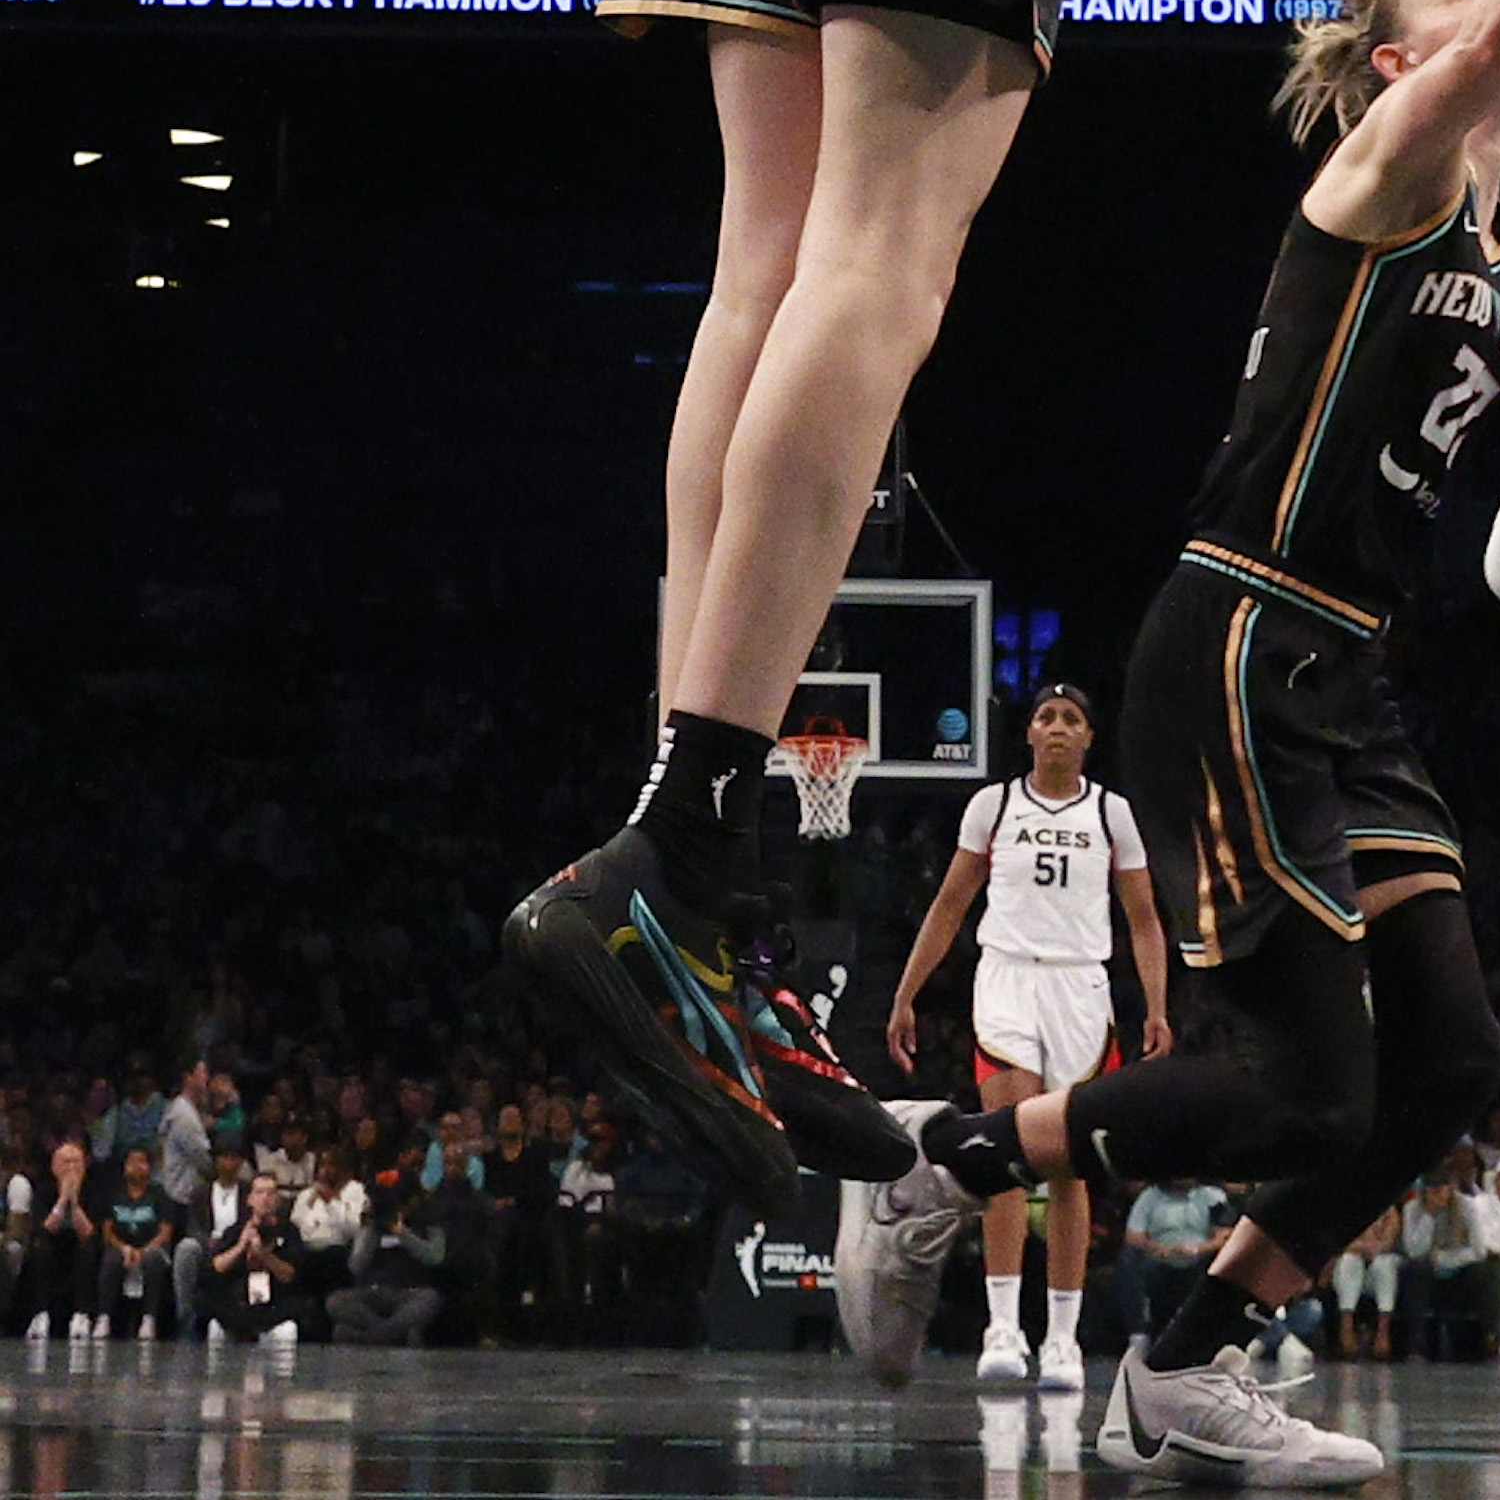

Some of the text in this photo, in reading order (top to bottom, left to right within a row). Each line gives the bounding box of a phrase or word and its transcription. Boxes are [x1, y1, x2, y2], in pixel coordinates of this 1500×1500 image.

[1410, 271, 1492, 328] NEW
[932, 743, 972, 760] AT&T
[1015, 828, 1091, 850] ACES
[1034, 853, 1068, 889] 51
